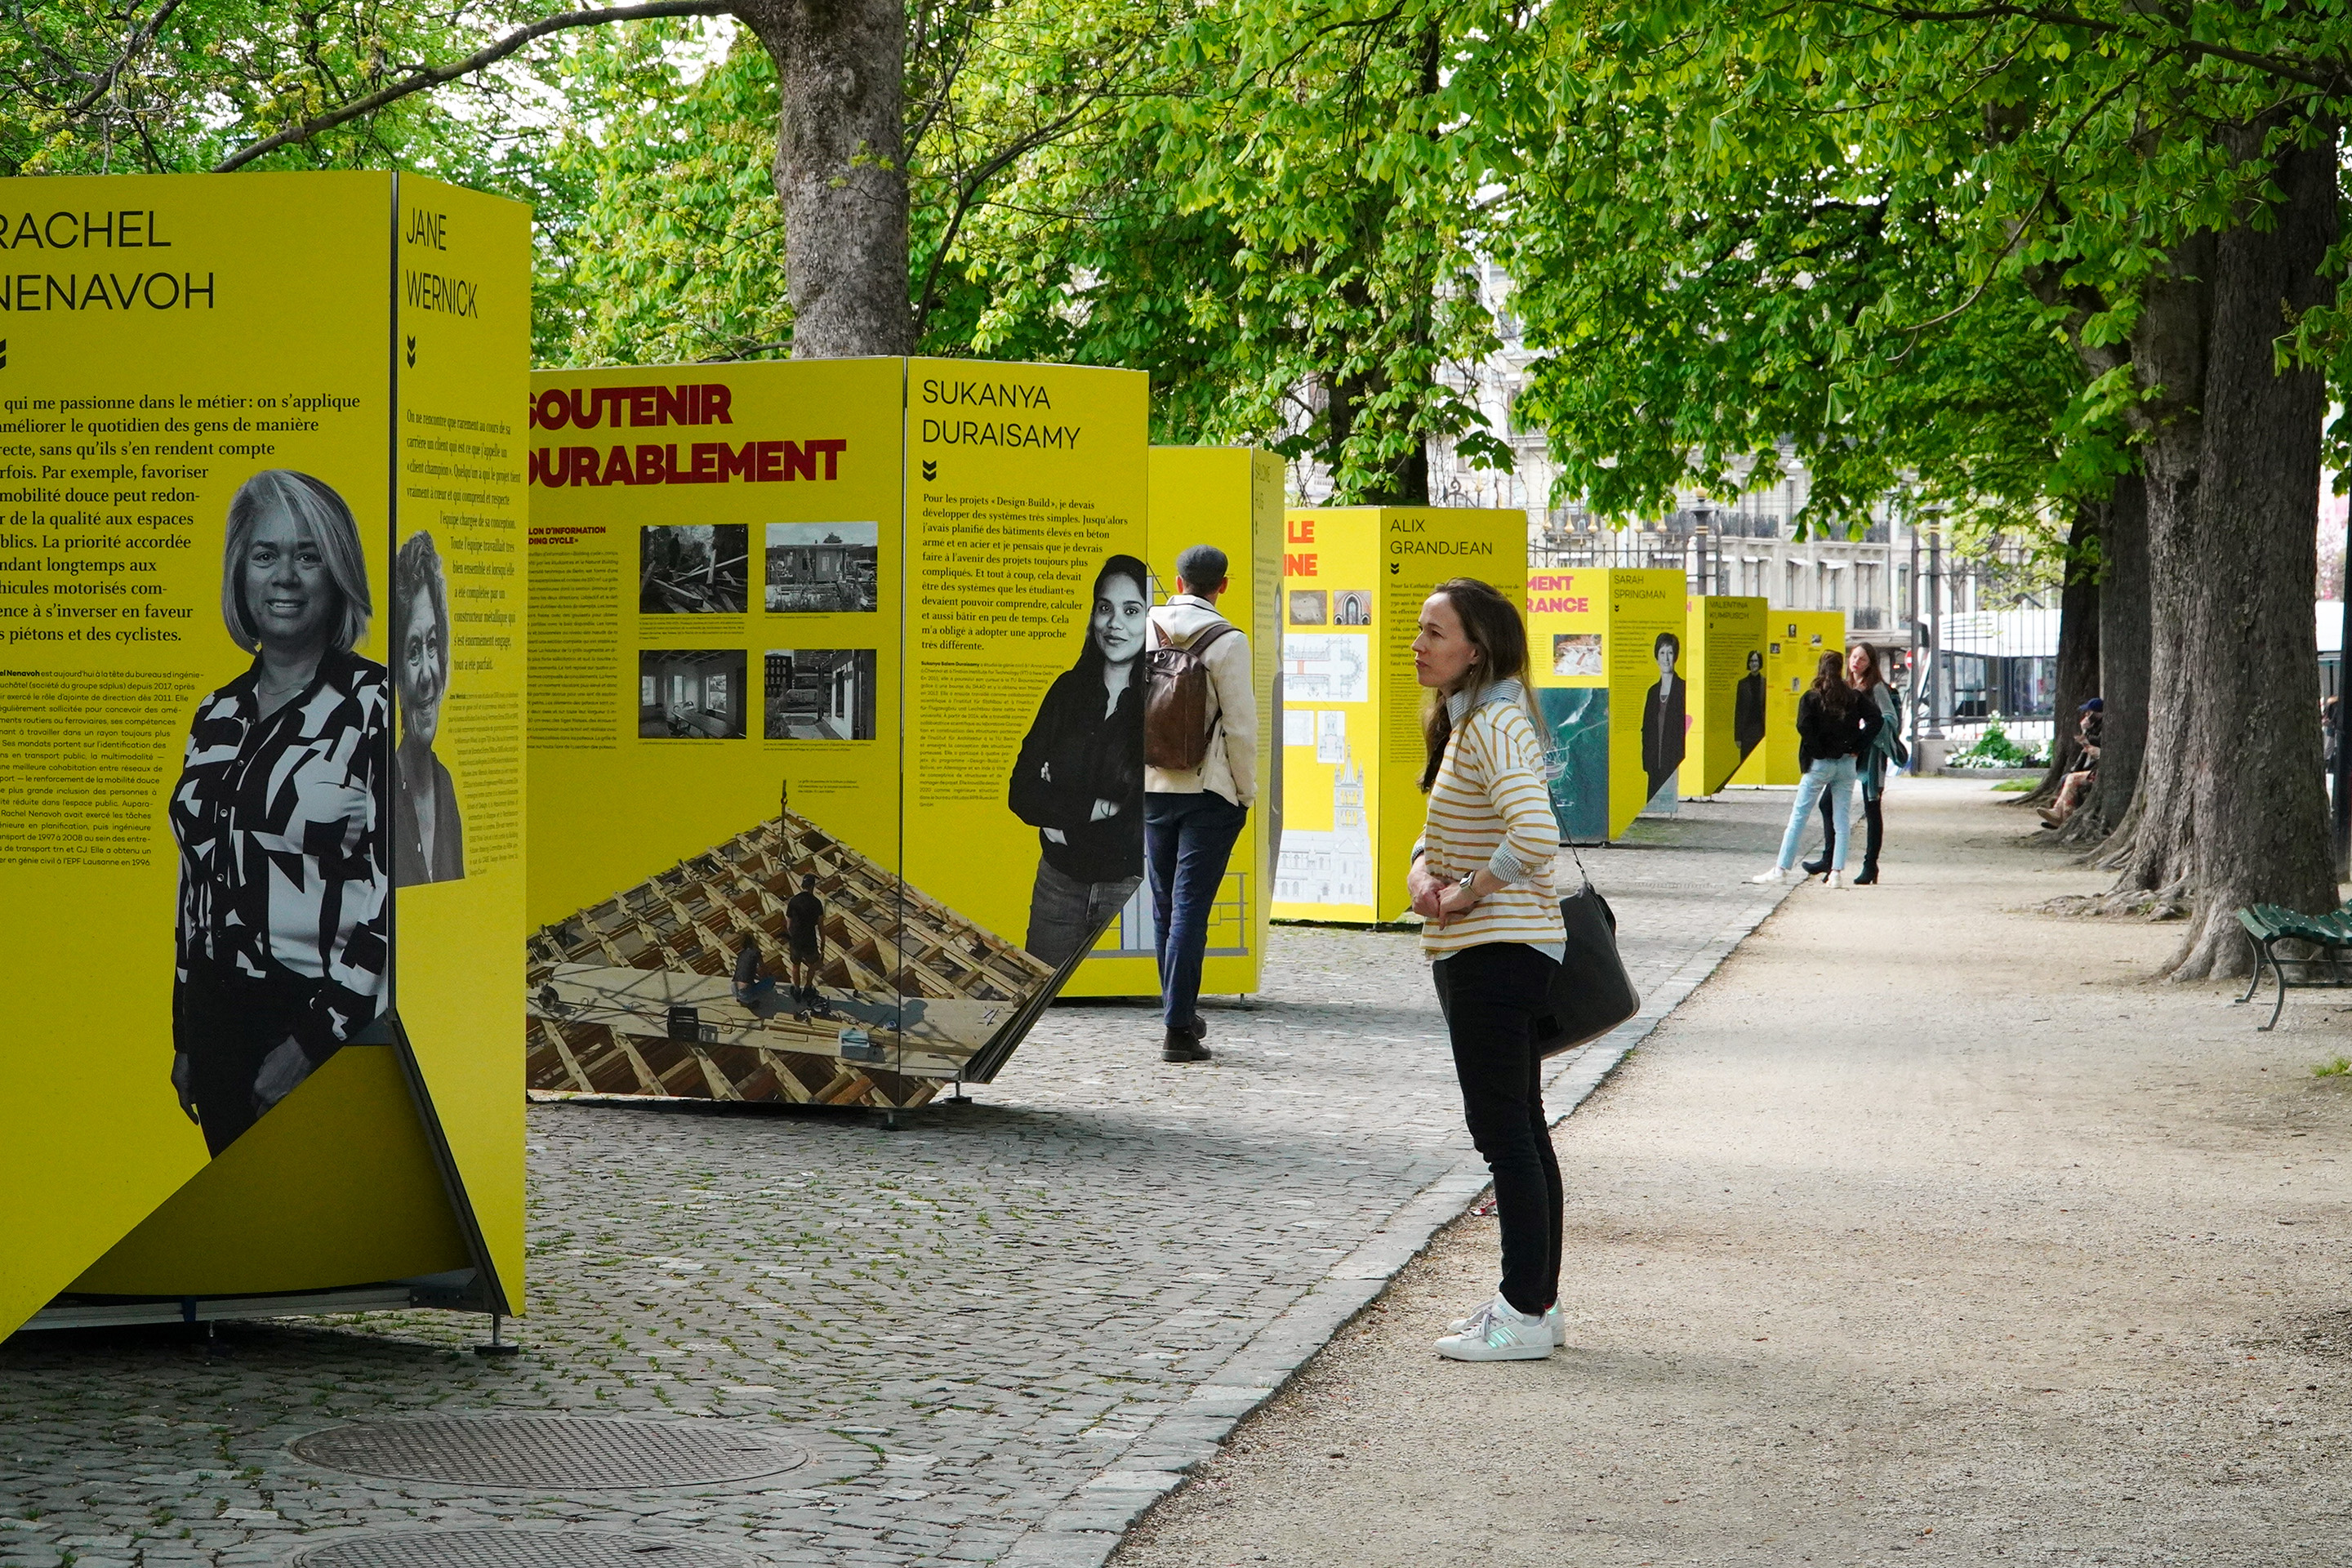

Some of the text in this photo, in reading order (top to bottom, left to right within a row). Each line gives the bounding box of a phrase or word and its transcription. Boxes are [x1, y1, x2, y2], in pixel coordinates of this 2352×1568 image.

[407, 207, 446, 251] JANE
[407, 270, 478, 318] WERNICK
[923, 380, 1050, 409] SUKANYA
[4, 396, 28, 414] qui
[33, 400, 56, 409] me
[60, 395, 135, 413] passionne
[139, 394, 175, 408] dans
[180, 394, 192, 408] le
[257, 399, 276, 408] on
[529, 384, 733, 430] OUTENIR
[71, 418, 83, 432] le
[88, 418, 159, 437] quotidien
[165, 417, 189, 432] des
[194, 422, 228, 436] gens
[234, 417, 251, 431] de
[256, 418, 318, 431] manière
[923, 420, 1080, 449] DURAISAMY
[39, 446, 72, 456] sans
[155, 441, 213, 455] rendent
[219, 443, 274, 459] compte
[529, 439, 846, 488] URABLEMENT
[42, 464, 208, 483] Par exemple, favoriser
[65, 488, 109, 501] douce
[114, 490, 146, 506] peut
[152, 487, 199, 501] redon-
[924, 493, 943, 502] Pour
[946, 494, 957, 503] les
[960, 496, 988, 506] projets
[1060, 500, 1067, 510] je
[1068, 500, 1094, 509] devais
[10, 511, 194, 529] de la qualité aux espaces
[923, 508, 970, 521] développer
[973, 510, 987, 519] des
[989, 512, 1027, 522] systèmes
[1047, 514, 1080, 525] simples.
[952, 523, 983, 535] planifié
[987, 525, 1000, 534] des
[1003, 526, 1045, 536] bâtiments
[1047, 528, 1071, 537] élevés
[1086, 529, 1109, 538] béton
[1390, 519, 1425, 532] ALIX
[42, 534, 191, 552] La priorité accordée
[1390, 541, 1492, 555] GRANDJEAN
[47, 557, 157, 576] longtemps aux
[923, 552, 942, 561] faire
[987, 554, 1000, 564] des
[1003, 555, 1031, 566] projets
[1034, 557, 1068, 567] toujours
[1071, 557, 1088, 568] plus
[922, 567, 973, 579] compliqués.
[976, 568, 984, 577] Et
[1006, 570, 1011, 578] à
[1013, 572, 1036, 581] coup,
[1038, 571, 1054, 580] cela
[1057, 571, 1081, 581] devait
[1614, 575, 1644, 584] SARAH
[54, 581, 167, 595] motorisés com-
[941, 581, 956, 590] des
[958, 584, 995, 594] systèmes
[998, 586, 1013, 595] que
[1016, 584, 1027, 594] les
[1614, 589, 1666, 599] SPRINGMAN
[33, 604, 41, 617] à
[122, 608, 140, 617] en
[145, 604, 193, 617] faveur
[922, 596, 1083, 610] devaient pouvoir comprendre, calculer
[1710, 601, 1748, 609] VALENTINA
[933, 612, 953, 620] aussi
[956, 611, 976, 621] bâtir
[991, 616, 1006, 624] peu
[1009, 612, 1019, 622] de
[1022, 616, 1049, 626] temps.
[1051, 615, 1069, 623] Cela
[10, 626, 181, 645] piétons et des cyclistes.
[940, 626, 965, 638] obligé
[969, 627, 973, 635] à
[975, 626, 1008, 639] adopter
[1028, 629, 1067, 639] approche
[940, 640, 984, 650] différente.
